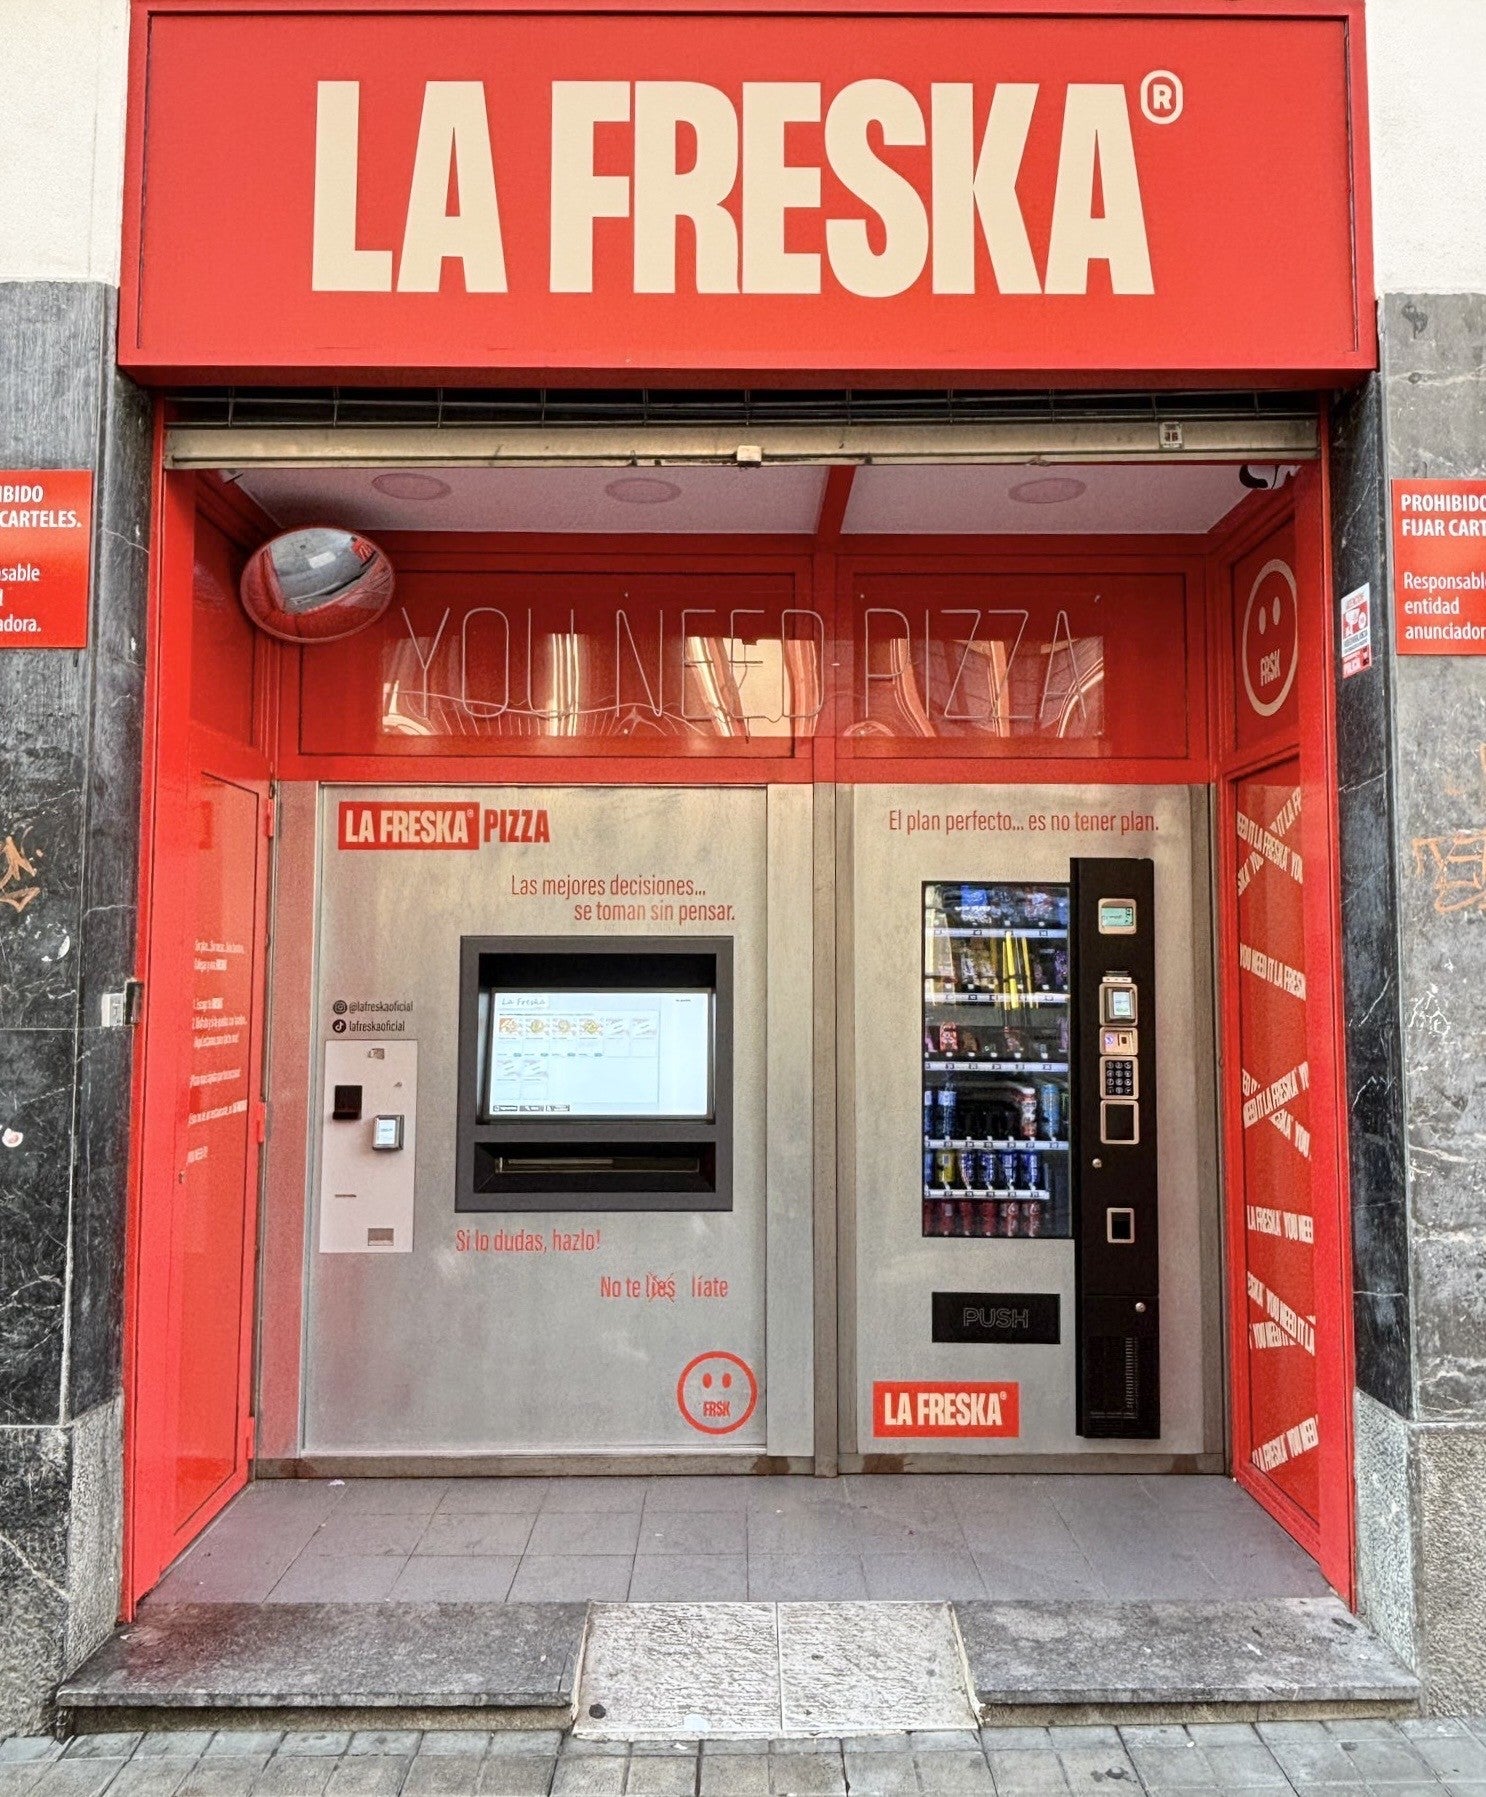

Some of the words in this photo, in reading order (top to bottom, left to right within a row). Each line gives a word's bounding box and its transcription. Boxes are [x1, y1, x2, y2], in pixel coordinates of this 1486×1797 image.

[311, 79, 508, 294] LA
[0, 509, 83, 528] CARTELES.
[1402, 518, 1446, 537] FIJAR
[1405, 596, 1460, 615] entidad
[402, 607, 576, 720] YOU
[616, 608, 824, 722] NEED
[865, 608, 1086, 721] PIZZA
[345, 809, 375, 843] LA
[484, 809, 550, 843] PIZZA
[889, 810, 902, 830] El
[907, 810, 940, 835] plan
[945, 810, 1024, 835] perfecto...
[1028, 814, 1046, 831] es
[1051, 814, 1070, 831] no
[1074, 812, 1116, 831] tener
[1120, 810, 1159, 835] plan.
[511, 875, 538, 896] Las
[543, 875, 606, 902] mejores
[610, 875, 706, 896] decisiones...
[574, 904, 592, 921] se
[596, 903, 646, 921] toman
[650, 900, 674, 921] sin
[679, 903, 735, 925] pensar.
[348, 1001, 413, 1014] @lafreskaoficial
[349, 1020, 405, 1032] lafreskaoficial
[455, 1229, 470, 1251] Si
[475, 1229, 489, 1251] lo
[494, 1229, 548, 1254] dudas,
[553, 1229, 600, 1251] hazlo!
[600, 1276, 621, 1297] No
[625, 1277, 640, 1297] te
[962, 1307, 1029, 1329] PUSH
[703, 1401, 731, 1418] FRSK
[884, 1391, 913, 1426] LA
